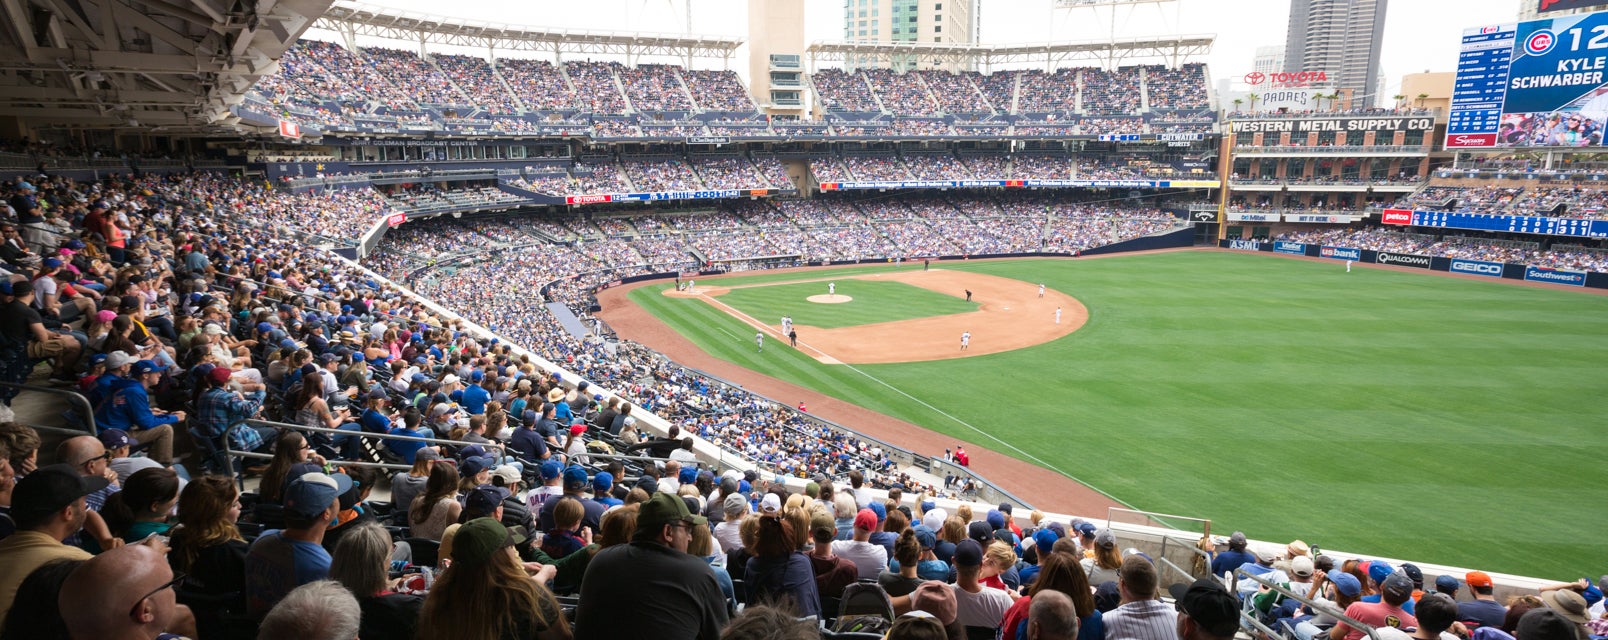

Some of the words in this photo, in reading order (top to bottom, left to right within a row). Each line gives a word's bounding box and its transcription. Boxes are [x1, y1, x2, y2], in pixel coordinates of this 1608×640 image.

[1569, 25, 1608, 52] 12
[1557, 56, 1606, 72] KYLE
[1270, 72, 1327, 82] TOYOTA
[1511, 71, 1604, 90] SCHWARBER
[1263, 92, 1307, 105] PADRES
[1232, 120, 1294, 132] WESTERN
[1299, 120, 1344, 131] METAL
[1348, 119, 1402, 130] SUPPLY
[1408, 118, 1433, 130] CO.
[1455, 136, 1486, 145] Sycuan
[1230, 240, 1258, 250] ASML
[1453, 262, 1500, 274] GEICO
[1530, 270, 1576, 281] Southwest
